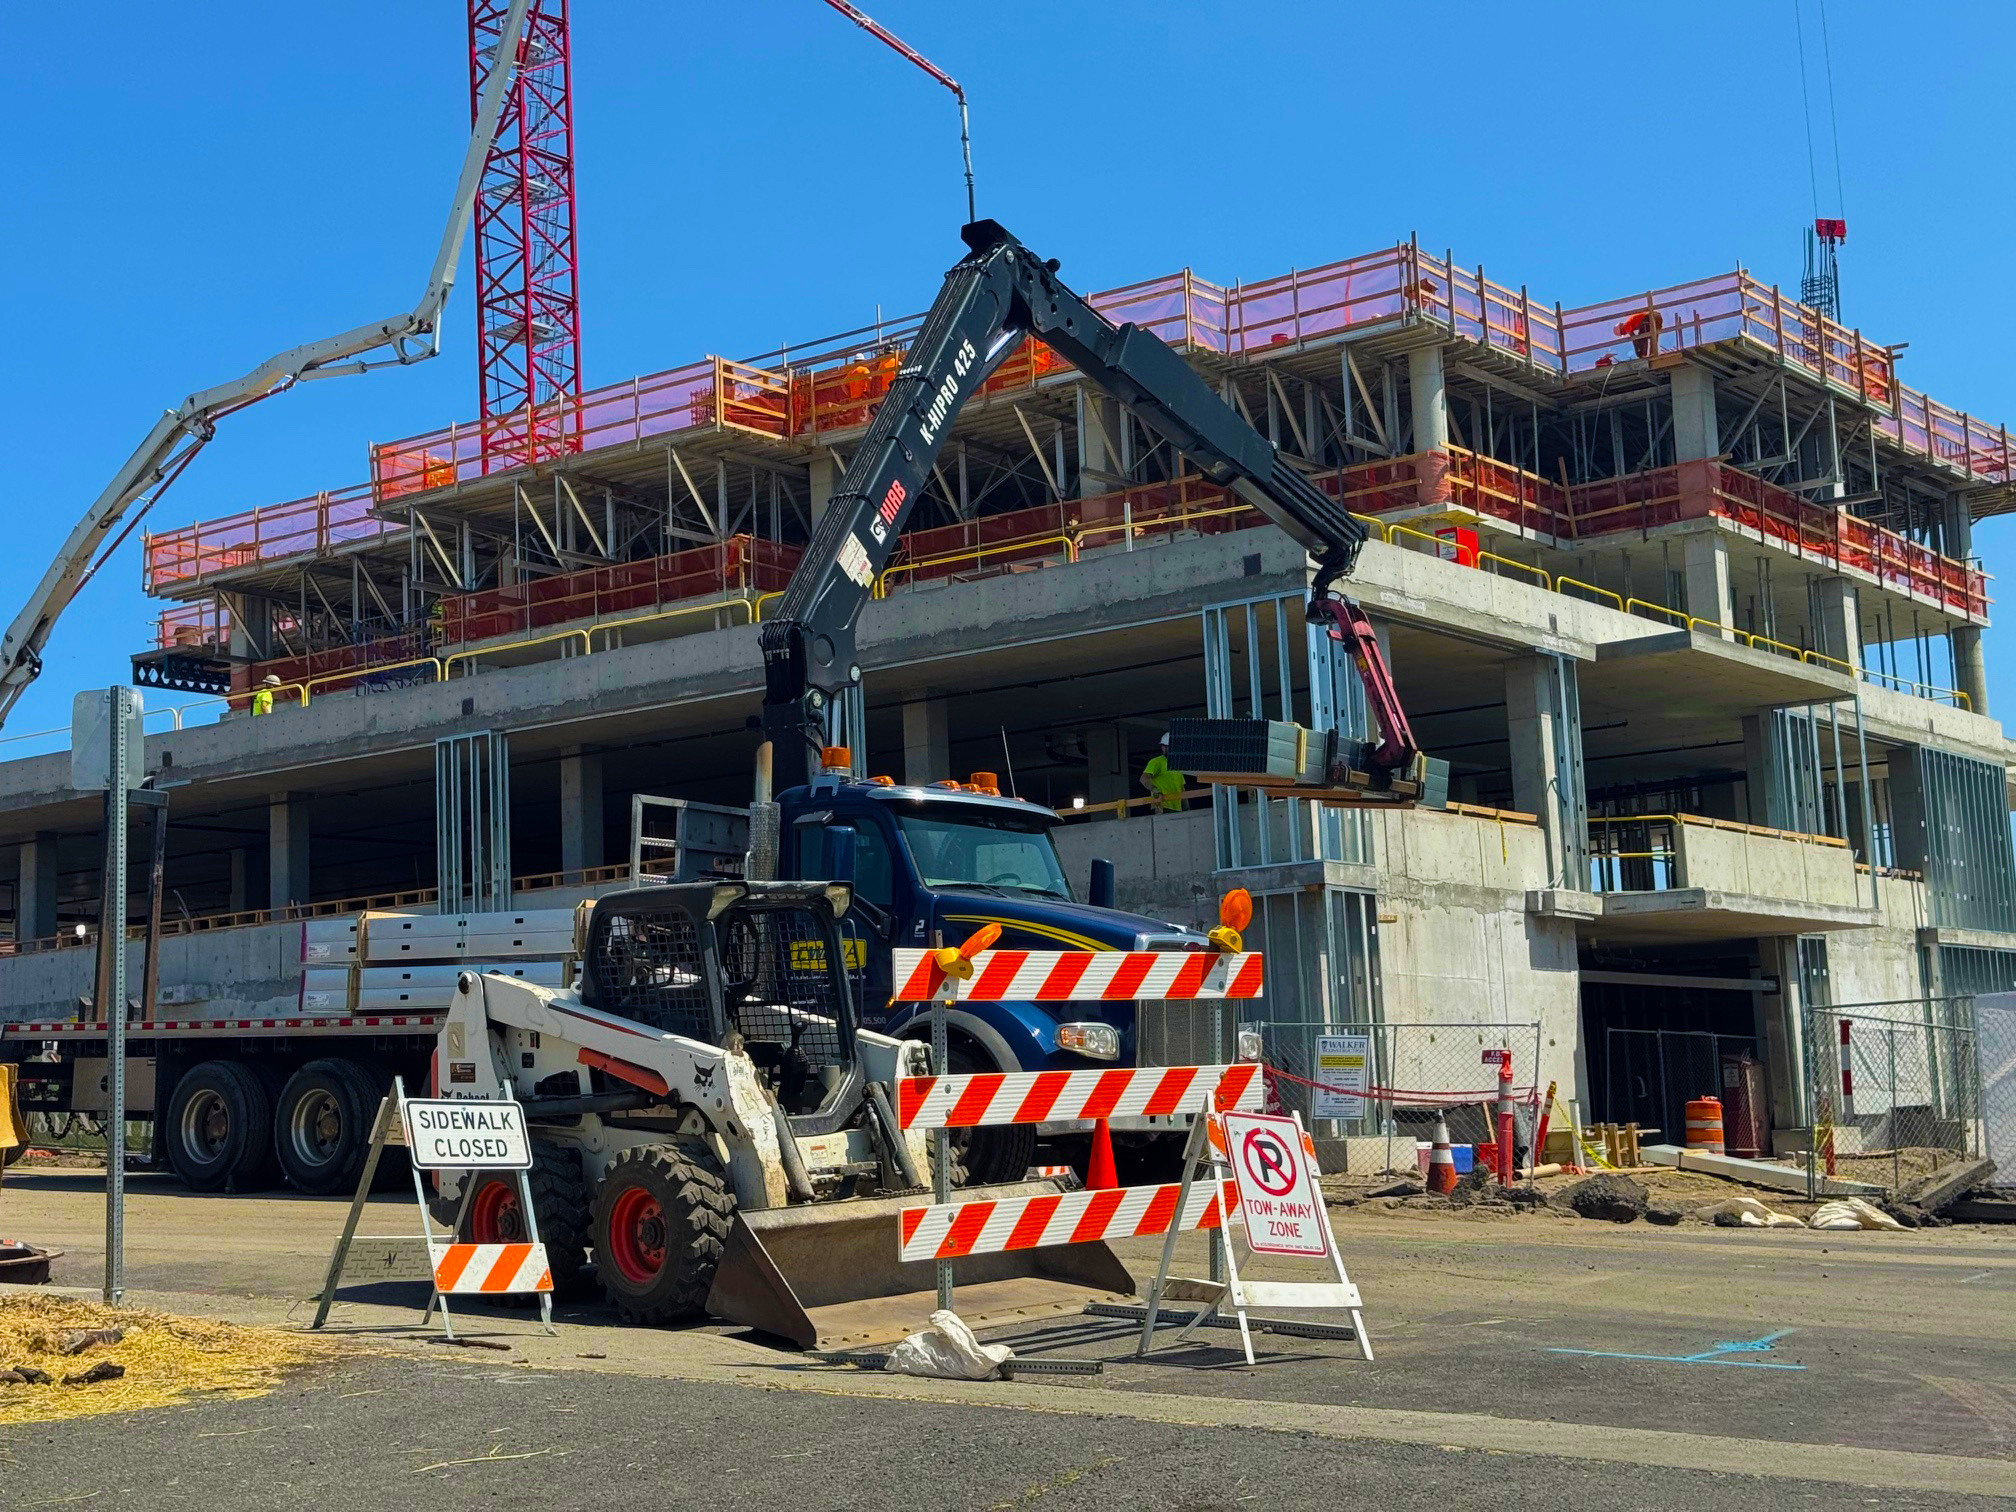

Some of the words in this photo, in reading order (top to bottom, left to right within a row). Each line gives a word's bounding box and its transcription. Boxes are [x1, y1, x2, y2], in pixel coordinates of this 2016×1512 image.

[919, 374, 959, 446] K-HIPRO
[953, 338, 977, 378] 425
[879, 479, 907, 526] HIAB
[126, 703, 132, 714] 3
[862, 1016, 887, 1026] 05,500
[1328, 1040, 1366, 1049] WALKER
[419, 1110, 514, 1130] SIDEWALK
[434, 1138, 508, 1158] CLOSED
[1245, 1198, 1312, 1220] TOW-AWAY
[1267, 1220, 1303, 1238] ZONE
